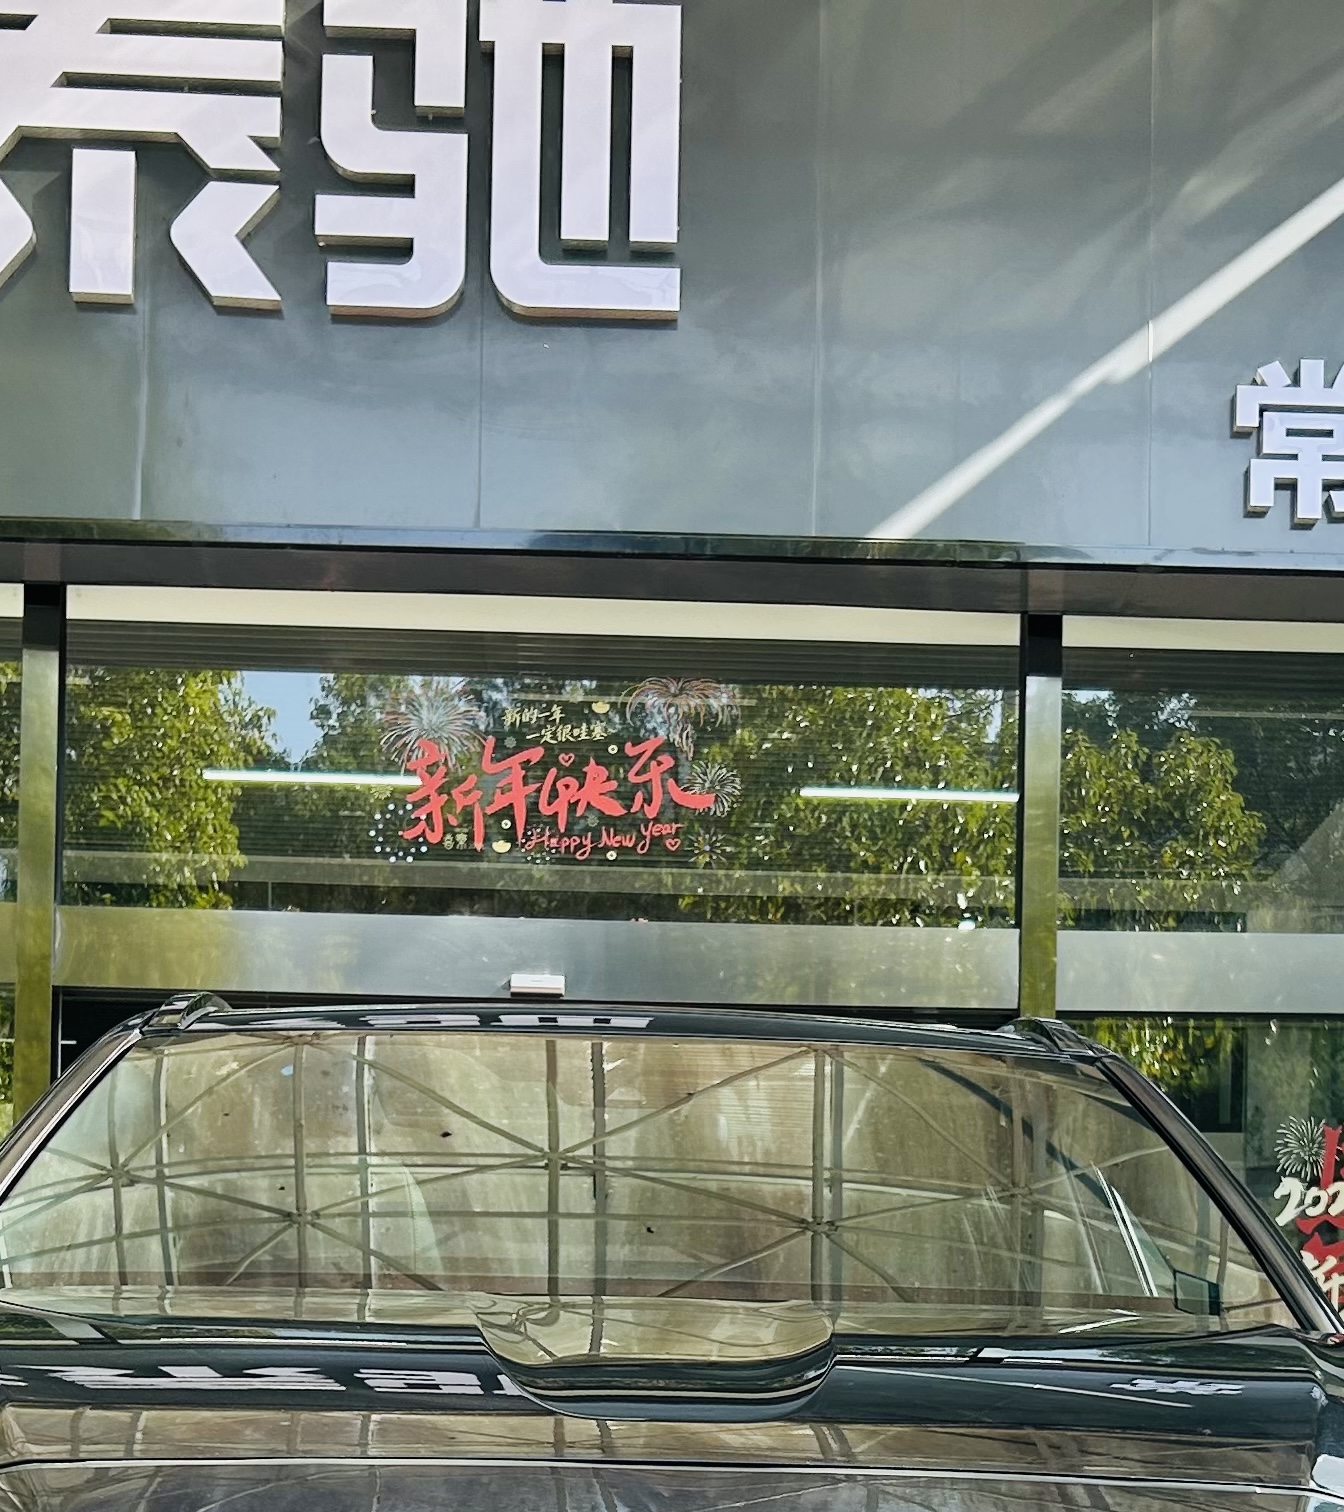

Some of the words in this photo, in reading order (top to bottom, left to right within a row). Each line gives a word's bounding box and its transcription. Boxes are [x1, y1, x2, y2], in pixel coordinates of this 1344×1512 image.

[501, 704, 566, 729] 新的一年
[402, 736, 715, 853] 新年快乐
[524, 826, 593, 861] Happy
[597, 825, 637, 848] New
